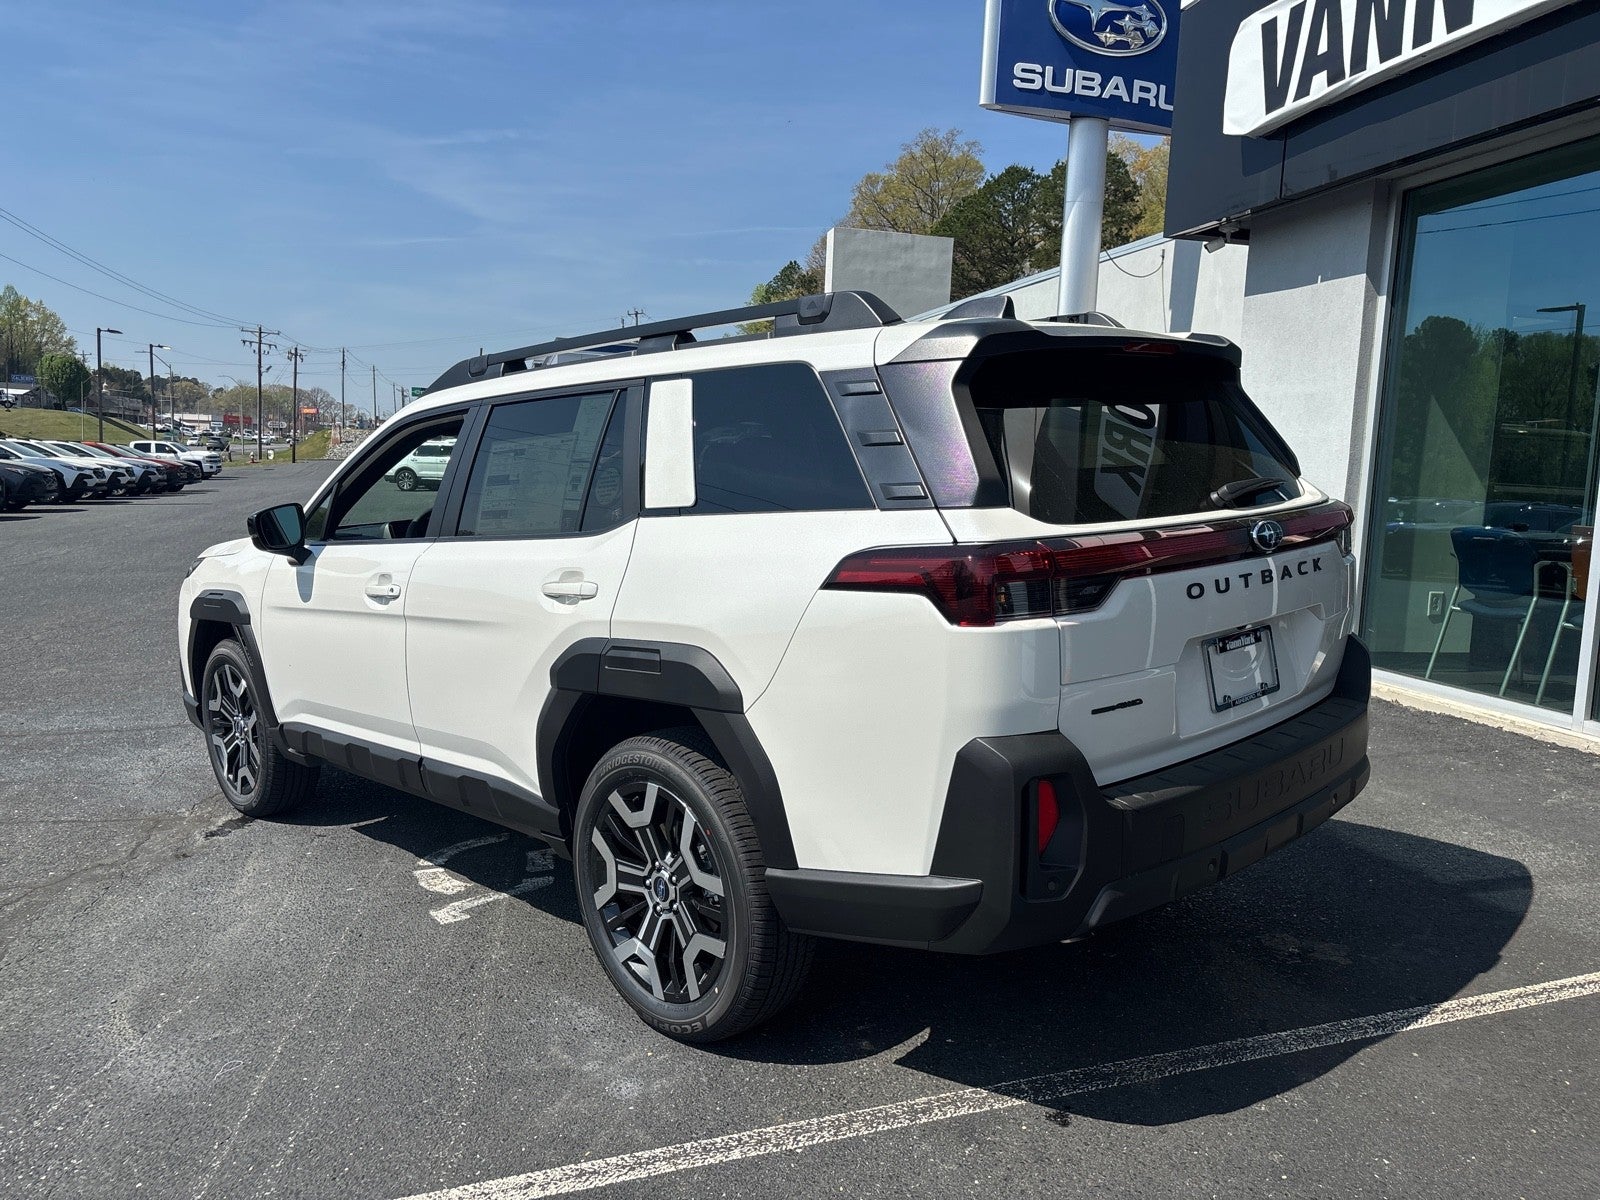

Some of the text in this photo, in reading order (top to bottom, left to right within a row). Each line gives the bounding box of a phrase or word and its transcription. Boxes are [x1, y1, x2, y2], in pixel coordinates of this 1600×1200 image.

[1186, 557, 1322, 600] OUTBACK
[600, 754, 665, 776] BRIDGESTONE
[1202, 737, 1344, 824] SUBARU
